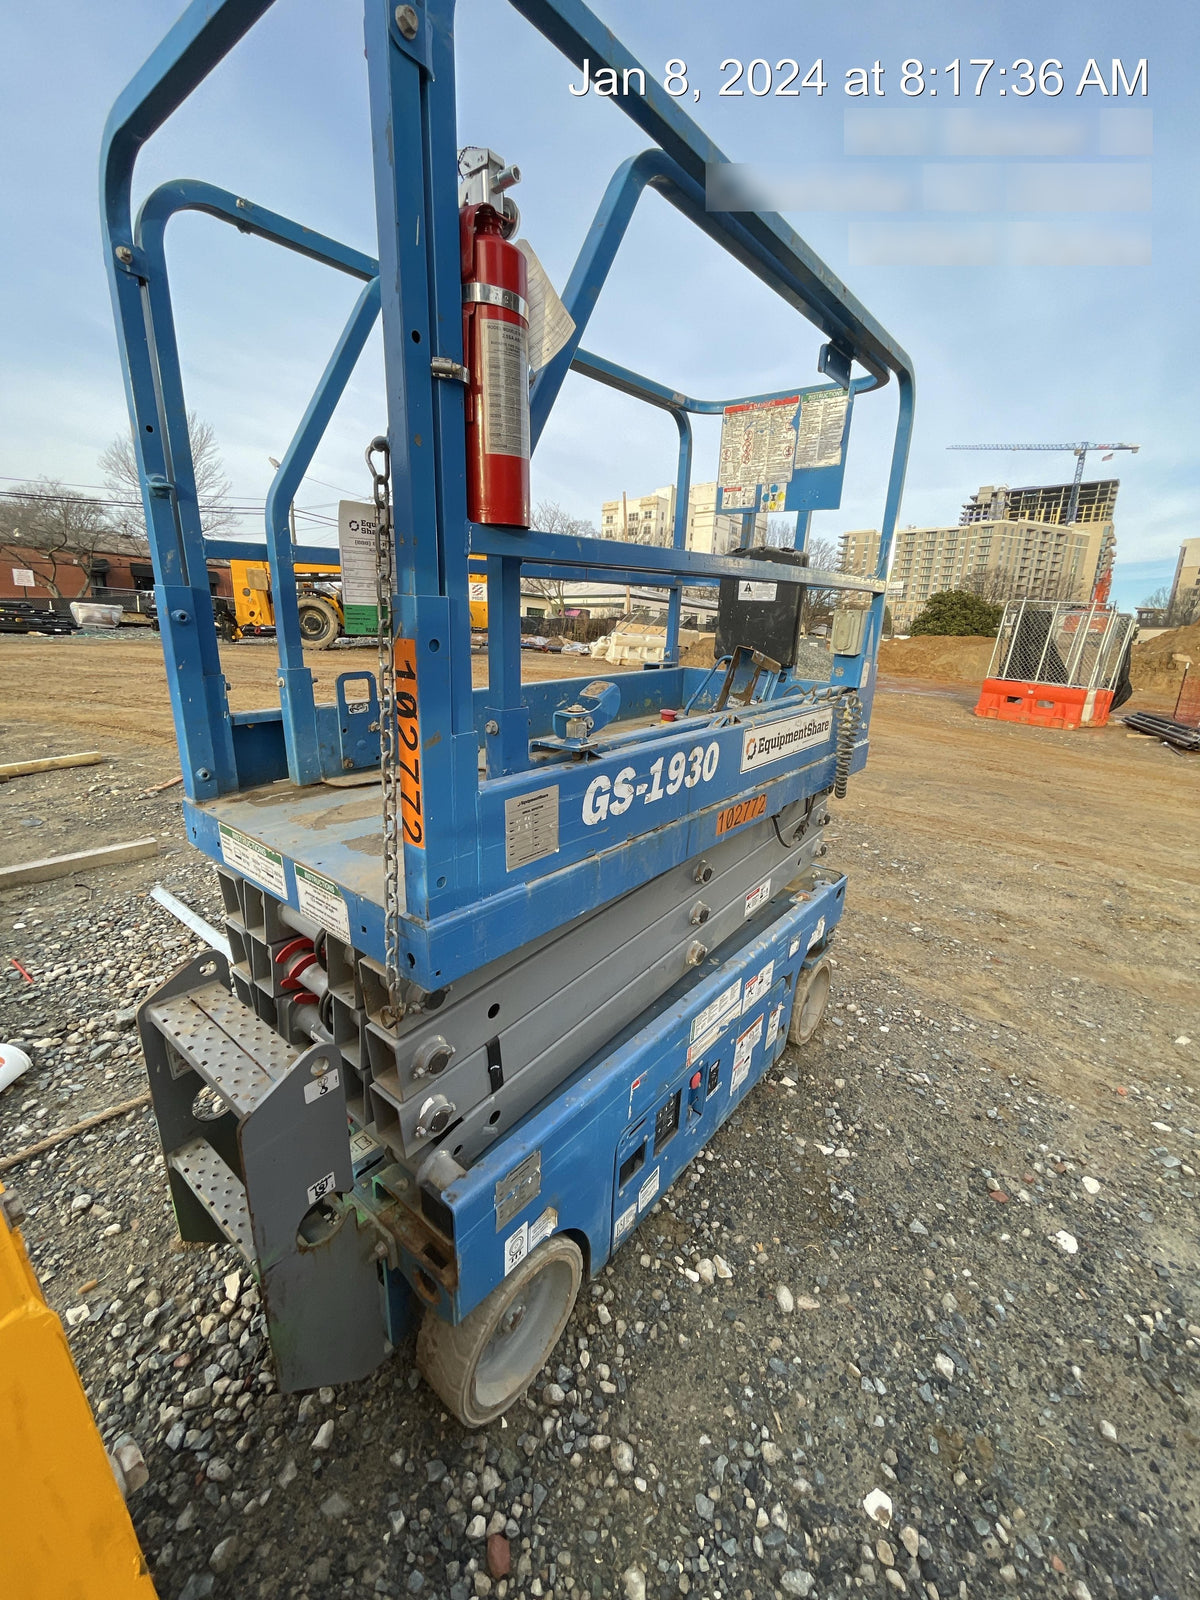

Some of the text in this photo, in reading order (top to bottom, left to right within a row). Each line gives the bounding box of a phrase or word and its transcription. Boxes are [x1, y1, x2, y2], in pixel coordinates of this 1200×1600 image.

[395, 660, 423, 844] 102772
[757, 720, 830, 754] EquipmentShare
[582, 741, 720, 826] GS-1930
[718, 794, 767, 833] 102772
